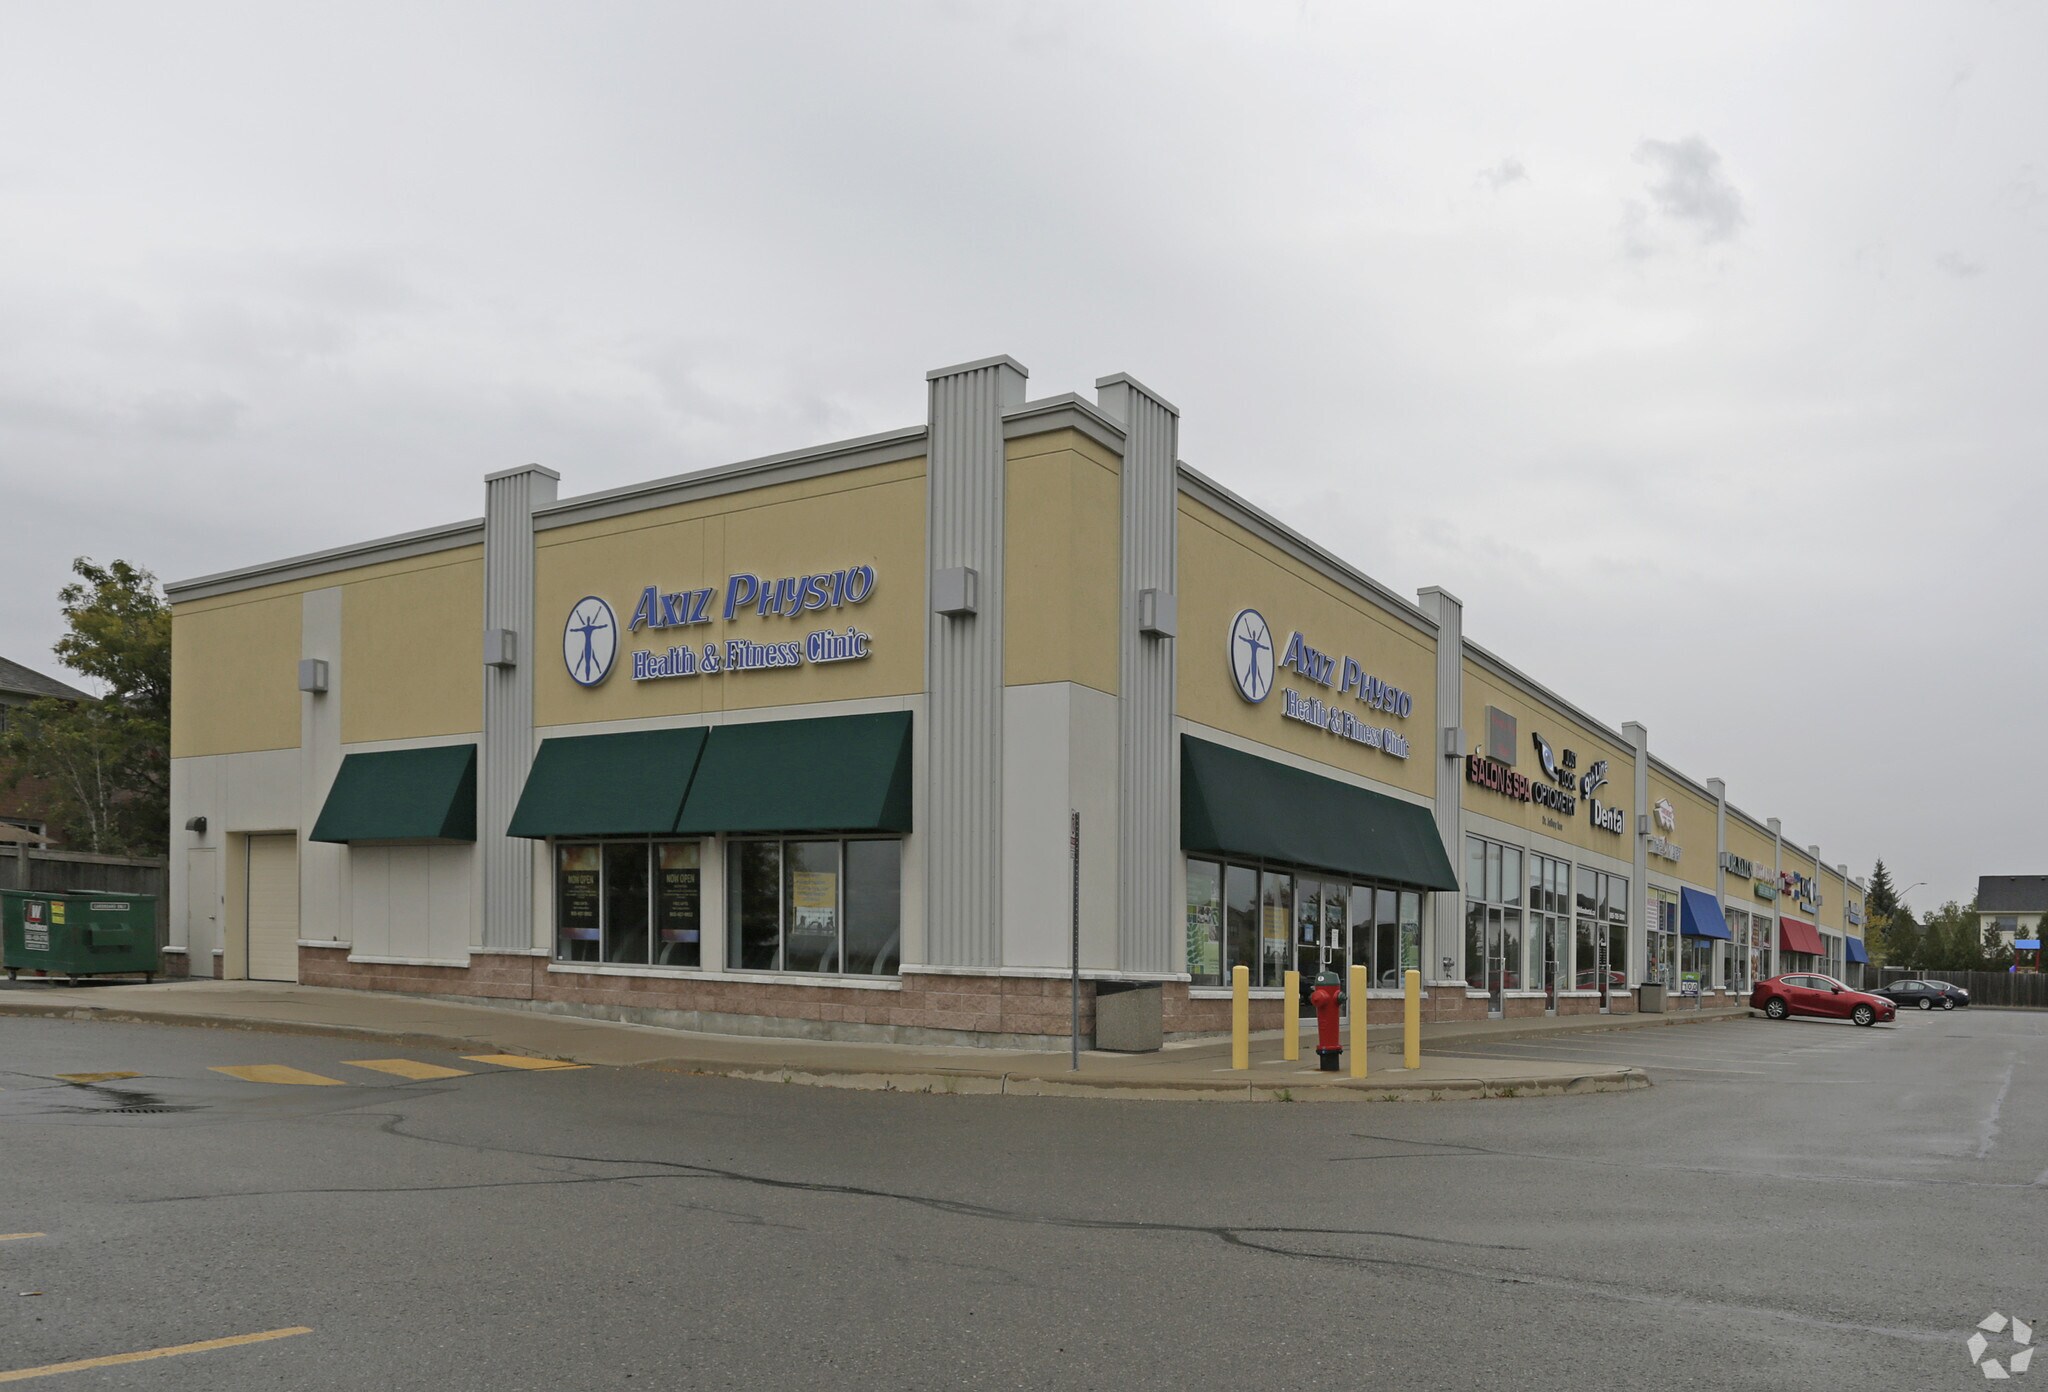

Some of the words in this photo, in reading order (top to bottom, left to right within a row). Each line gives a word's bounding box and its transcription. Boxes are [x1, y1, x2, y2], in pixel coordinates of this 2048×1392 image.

[631, 645, 696, 681] Health
[701, 643, 720, 673] &
[724, 638, 800, 671] Fitness
[806, 626, 870, 663] Clinic
[1283, 688, 1328, 729] Health
[1329, 706, 1342, 734] &
[1342, 710, 1381, 749] Fitness
[1382, 728, 1410, 759] Clinic
[1535, 782, 1577, 815] OPTOMETRY
[1595, 799, 1625, 834] Dental
[680, 874, 695, 883] OPEN
